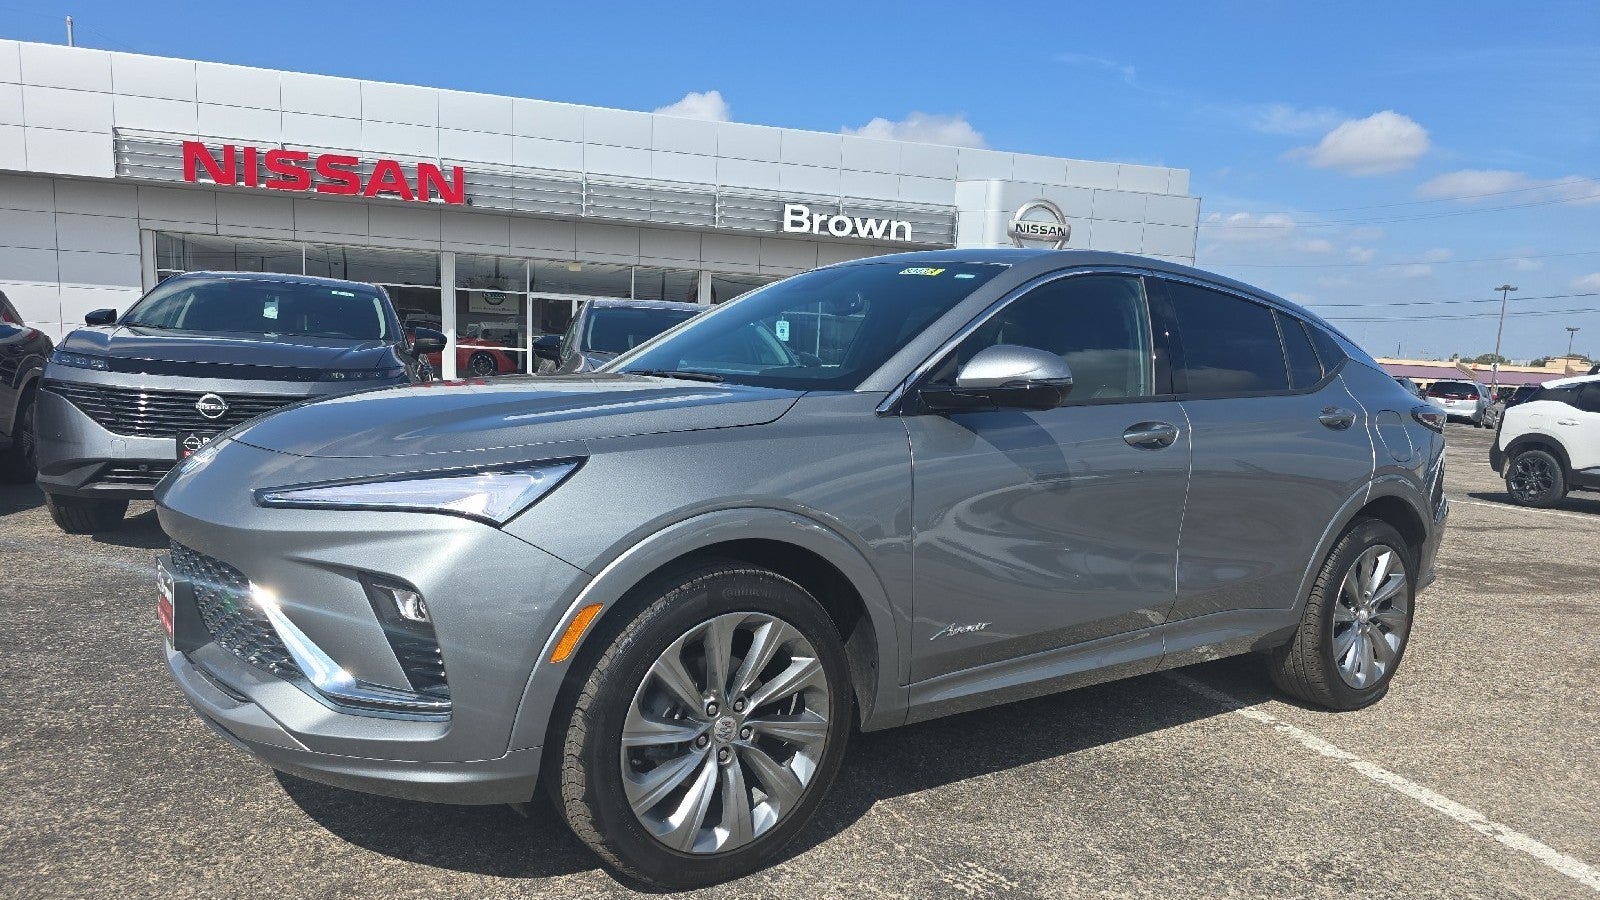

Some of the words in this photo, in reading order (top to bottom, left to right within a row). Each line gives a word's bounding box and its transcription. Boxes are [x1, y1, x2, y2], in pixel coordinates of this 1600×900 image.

[183, 141, 464, 205] NISSAN
[783, 203, 913, 242] Brown
[1014, 223, 1067, 237] NISSAN
[195, 402, 229, 410] NISSAN
